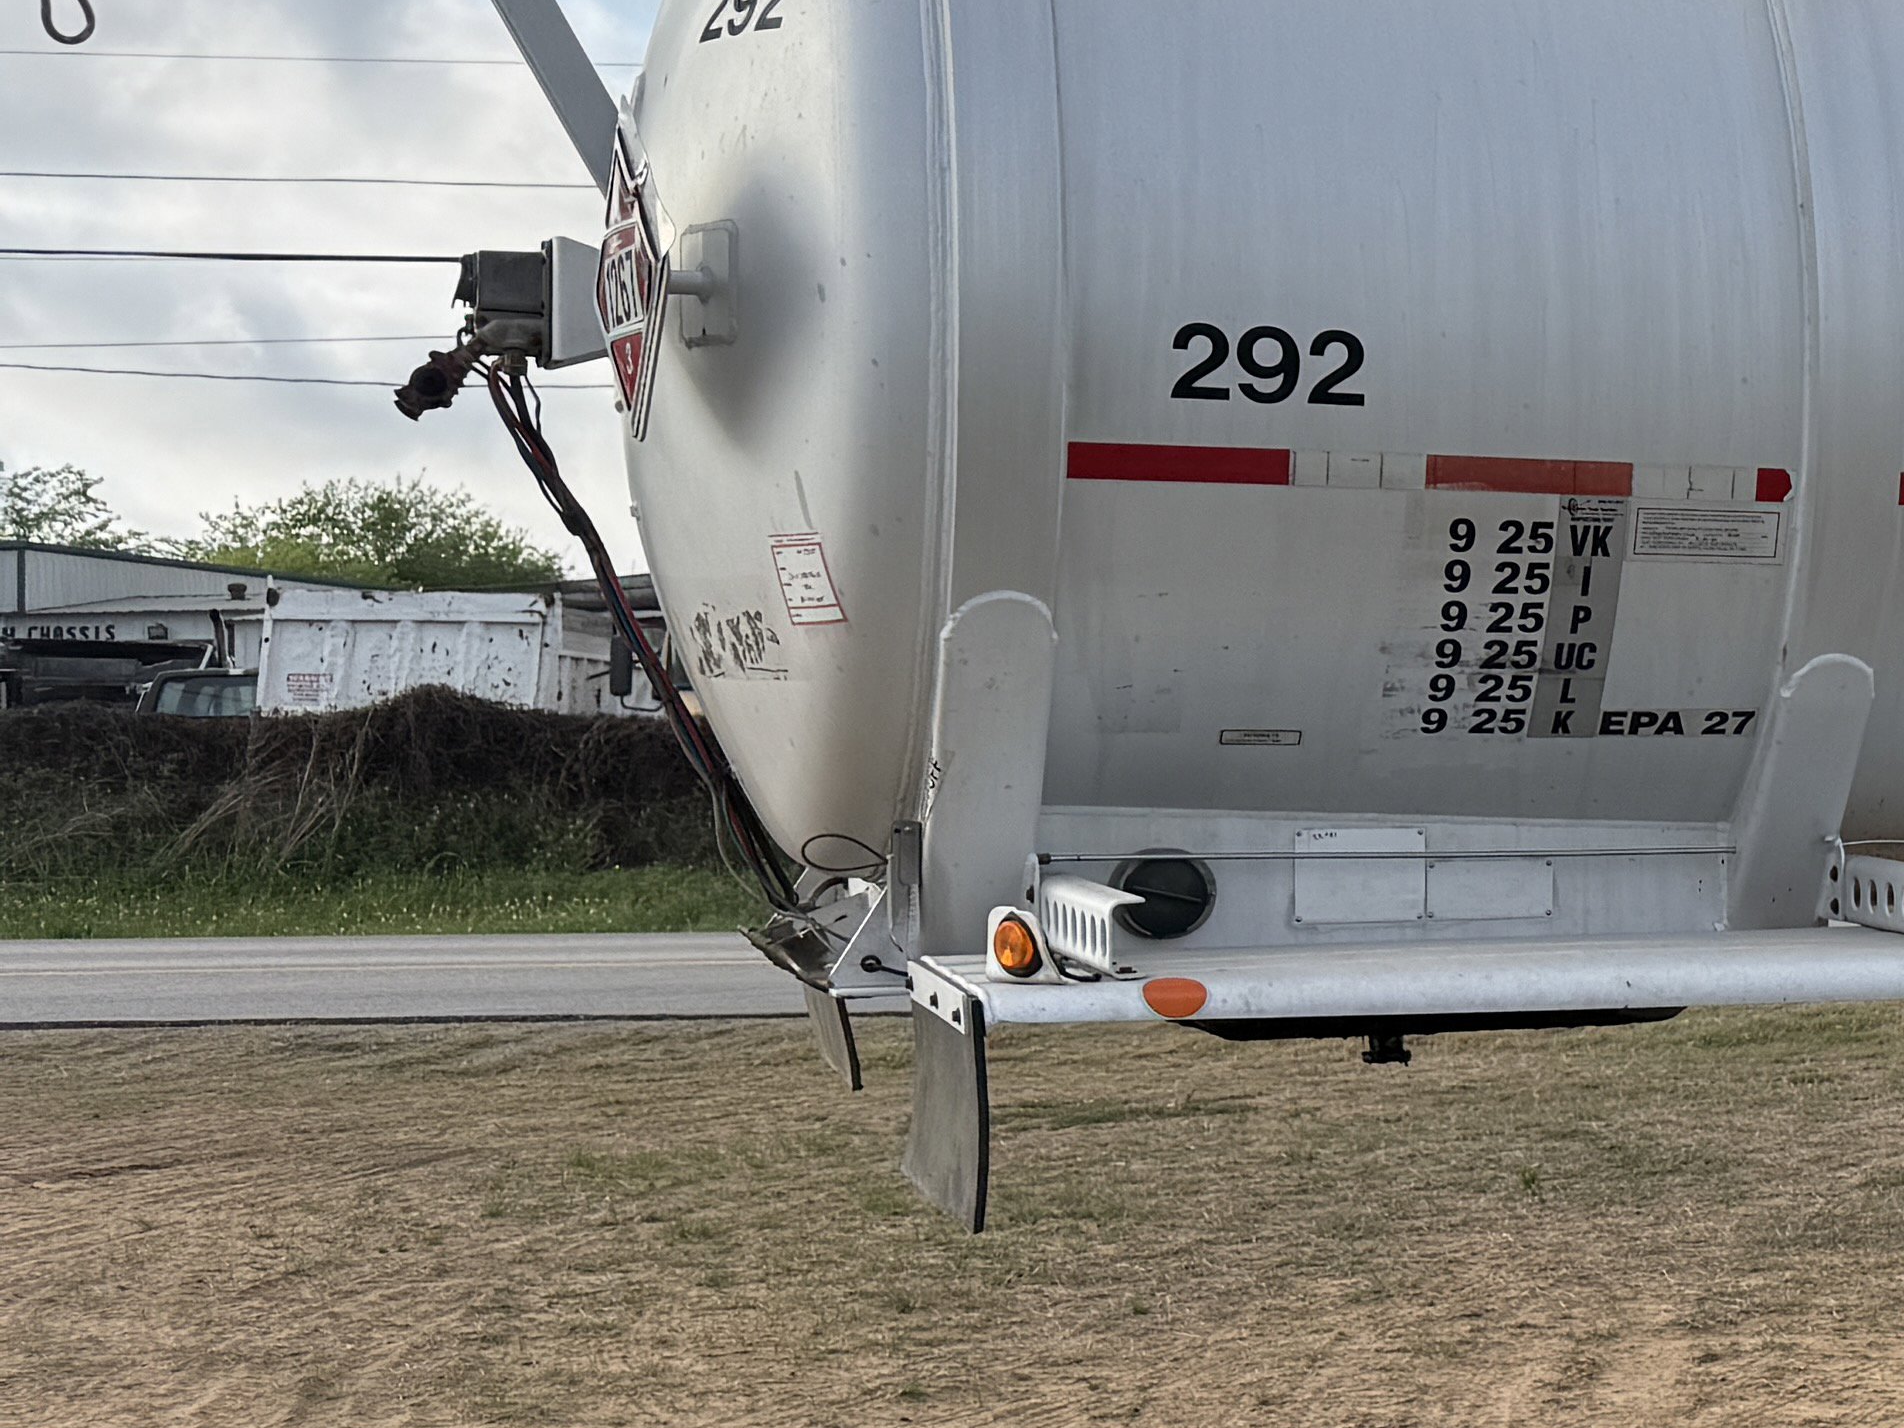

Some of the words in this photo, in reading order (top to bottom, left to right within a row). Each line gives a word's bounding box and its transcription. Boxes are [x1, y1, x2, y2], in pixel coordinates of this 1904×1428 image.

[604, 249, 643, 330] 1267
[624, 341, 634, 375] 3
[1170, 322, 1365, 406] 292
[1449, 518, 1476, 553] 9
[1496, 520, 1555, 554] 25
[1569, 525, 1614, 557] VK
[1443, 559, 1471, 593] 9
[1491, 562, 1550, 595] 25
[1580, 566, 1592, 597] I
[1440, 600, 1468, 632] 9
[1486, 602, 1545, 633] 25
[1569, 605, 1593, 634] P
[1435, 638, 1462, 669] 9
[1479, 640, 1539, 670] 25
[1553, 642, 1597, 670] UC
[1428, 673, 1456, 702] 9
[1474, 674, 1533, 703] 25
[1559, 677, 1576, 704] L
[1420, 707, 1448, 734] 9
[1468, 708, 1527, 735] 25
[1551, 710, 1574, 735] K
[1598, 710, 1685, 736] EPA
[1701, 710, 1756, 735] 27
